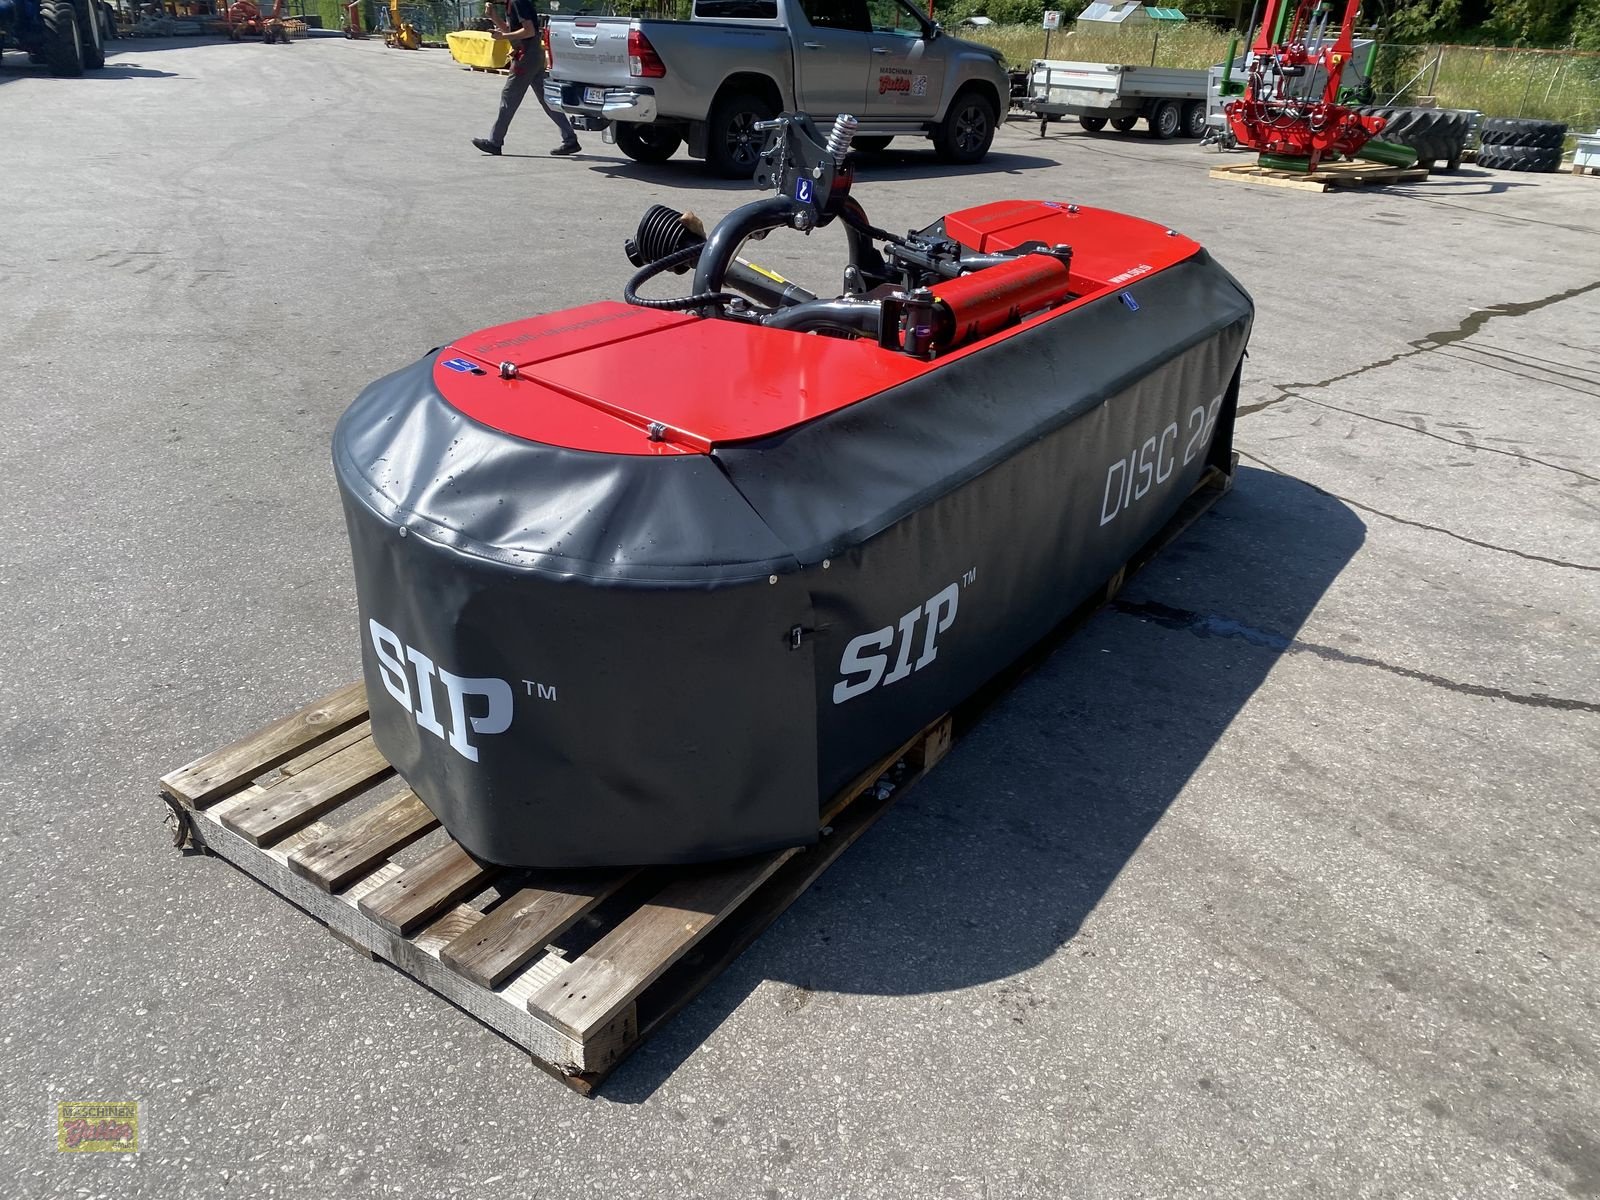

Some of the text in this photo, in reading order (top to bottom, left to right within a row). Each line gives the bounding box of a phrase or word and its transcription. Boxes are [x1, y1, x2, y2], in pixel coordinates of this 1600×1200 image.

[1100, 421, 1178, 527] DISC
[369, 618, 557, 763] SIP TM
[832, 582, 959, 705] SIP
